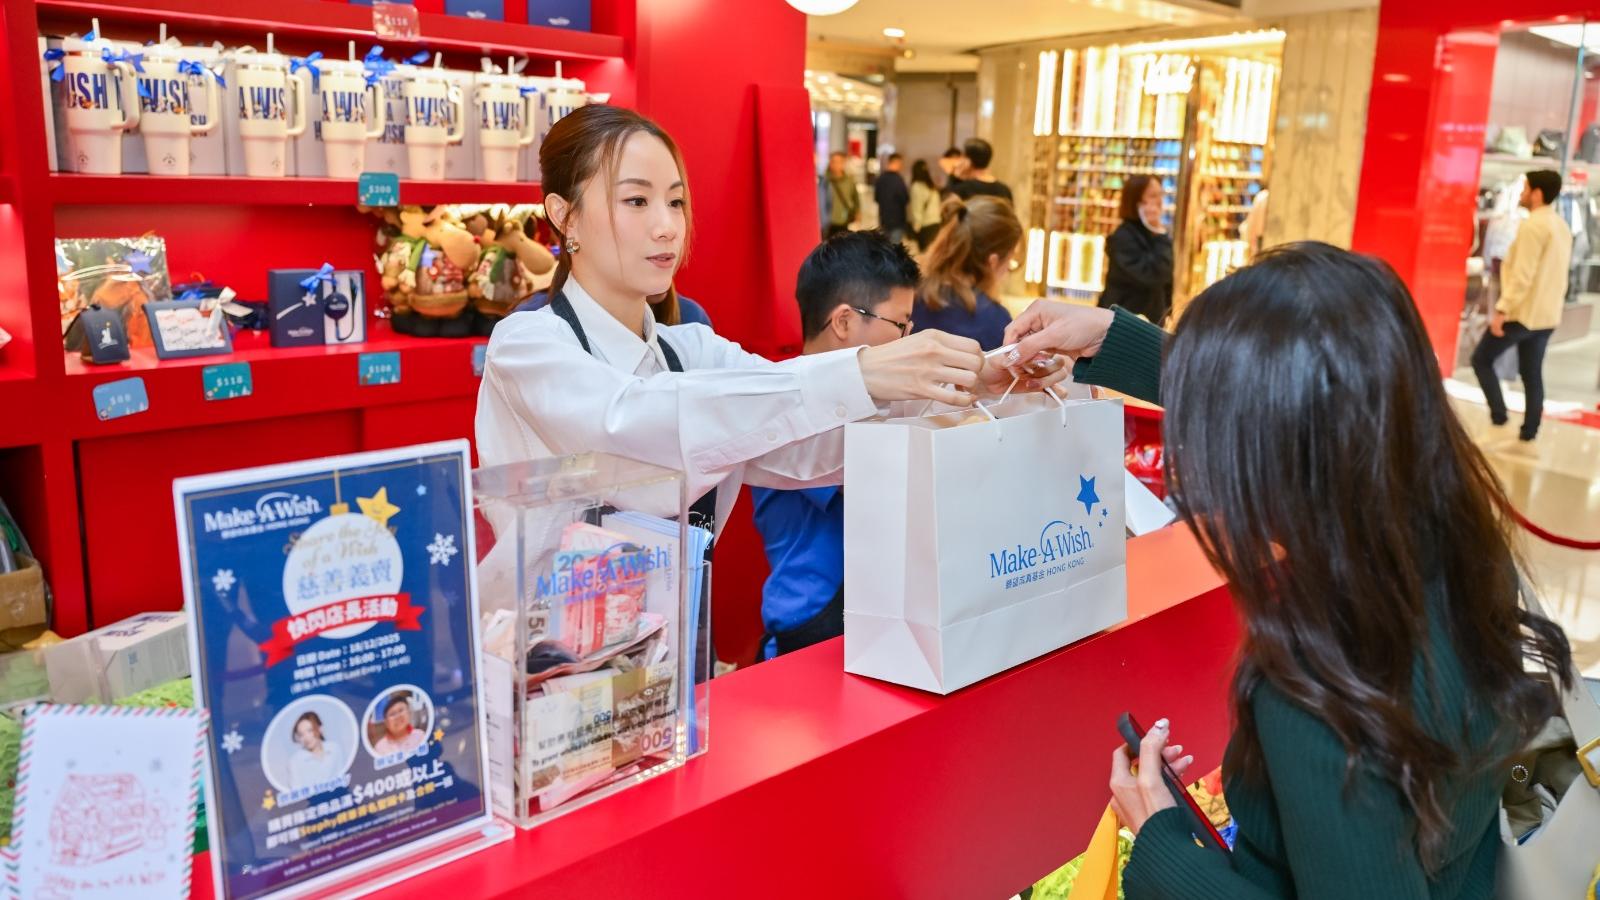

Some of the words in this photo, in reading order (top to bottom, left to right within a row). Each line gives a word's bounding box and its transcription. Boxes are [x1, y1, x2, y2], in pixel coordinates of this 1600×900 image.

[1046, 563, 1066, 577] HONG
[1067, 556, 1086, 569] KONG
[641, 728, 672, 751] 500
